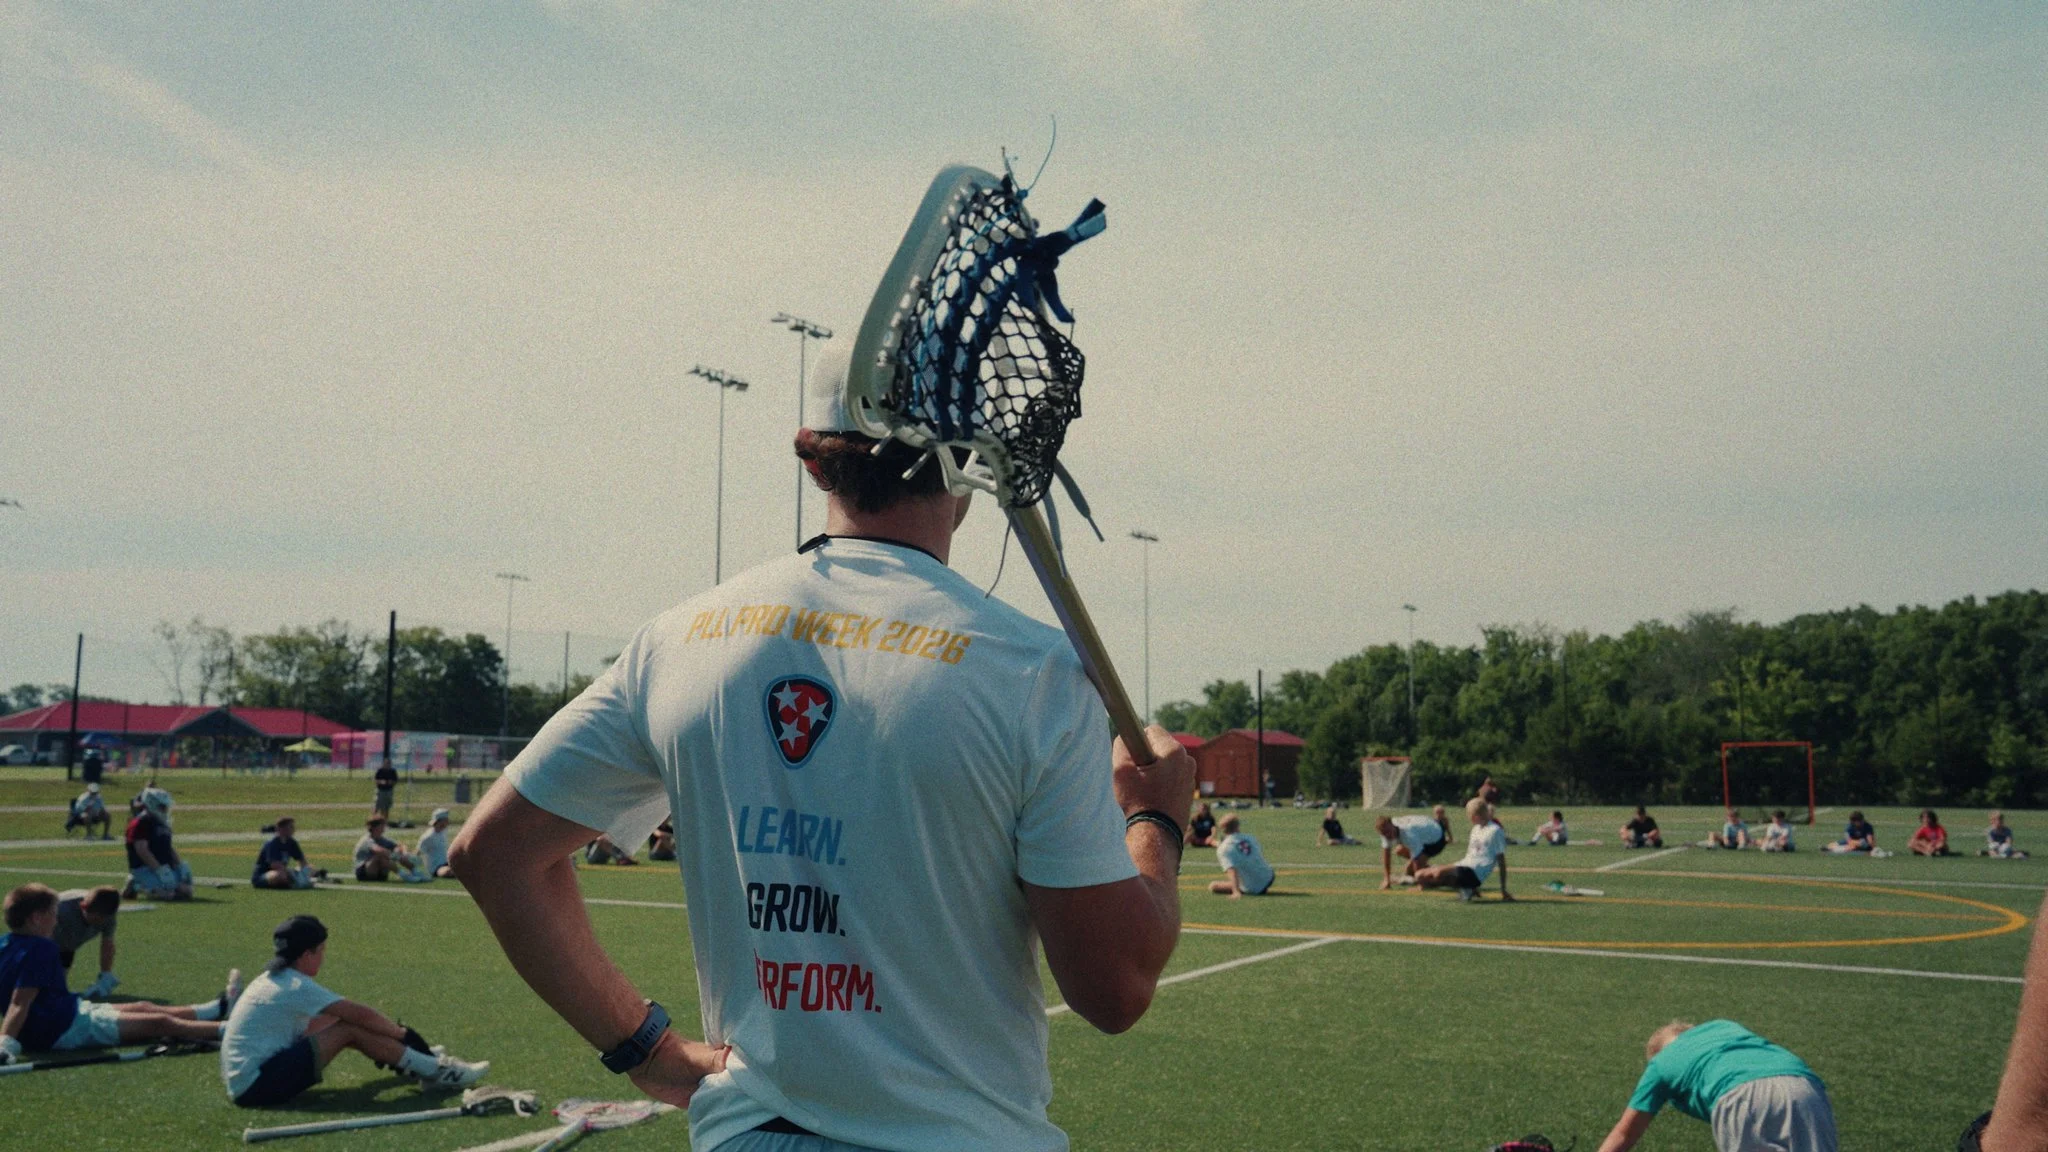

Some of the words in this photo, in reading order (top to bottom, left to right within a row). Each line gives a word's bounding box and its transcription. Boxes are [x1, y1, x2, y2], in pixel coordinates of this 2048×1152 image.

[730, 604, 791, 636] PRO
[792, 608, 883, 652] WEEK
[877, 620, 971, 665] 2026
[737, 806, 846, 866] LEARN.
[747, 882, 846, 937] GROW.
[754, 948, 882, 1013] RFORM.
